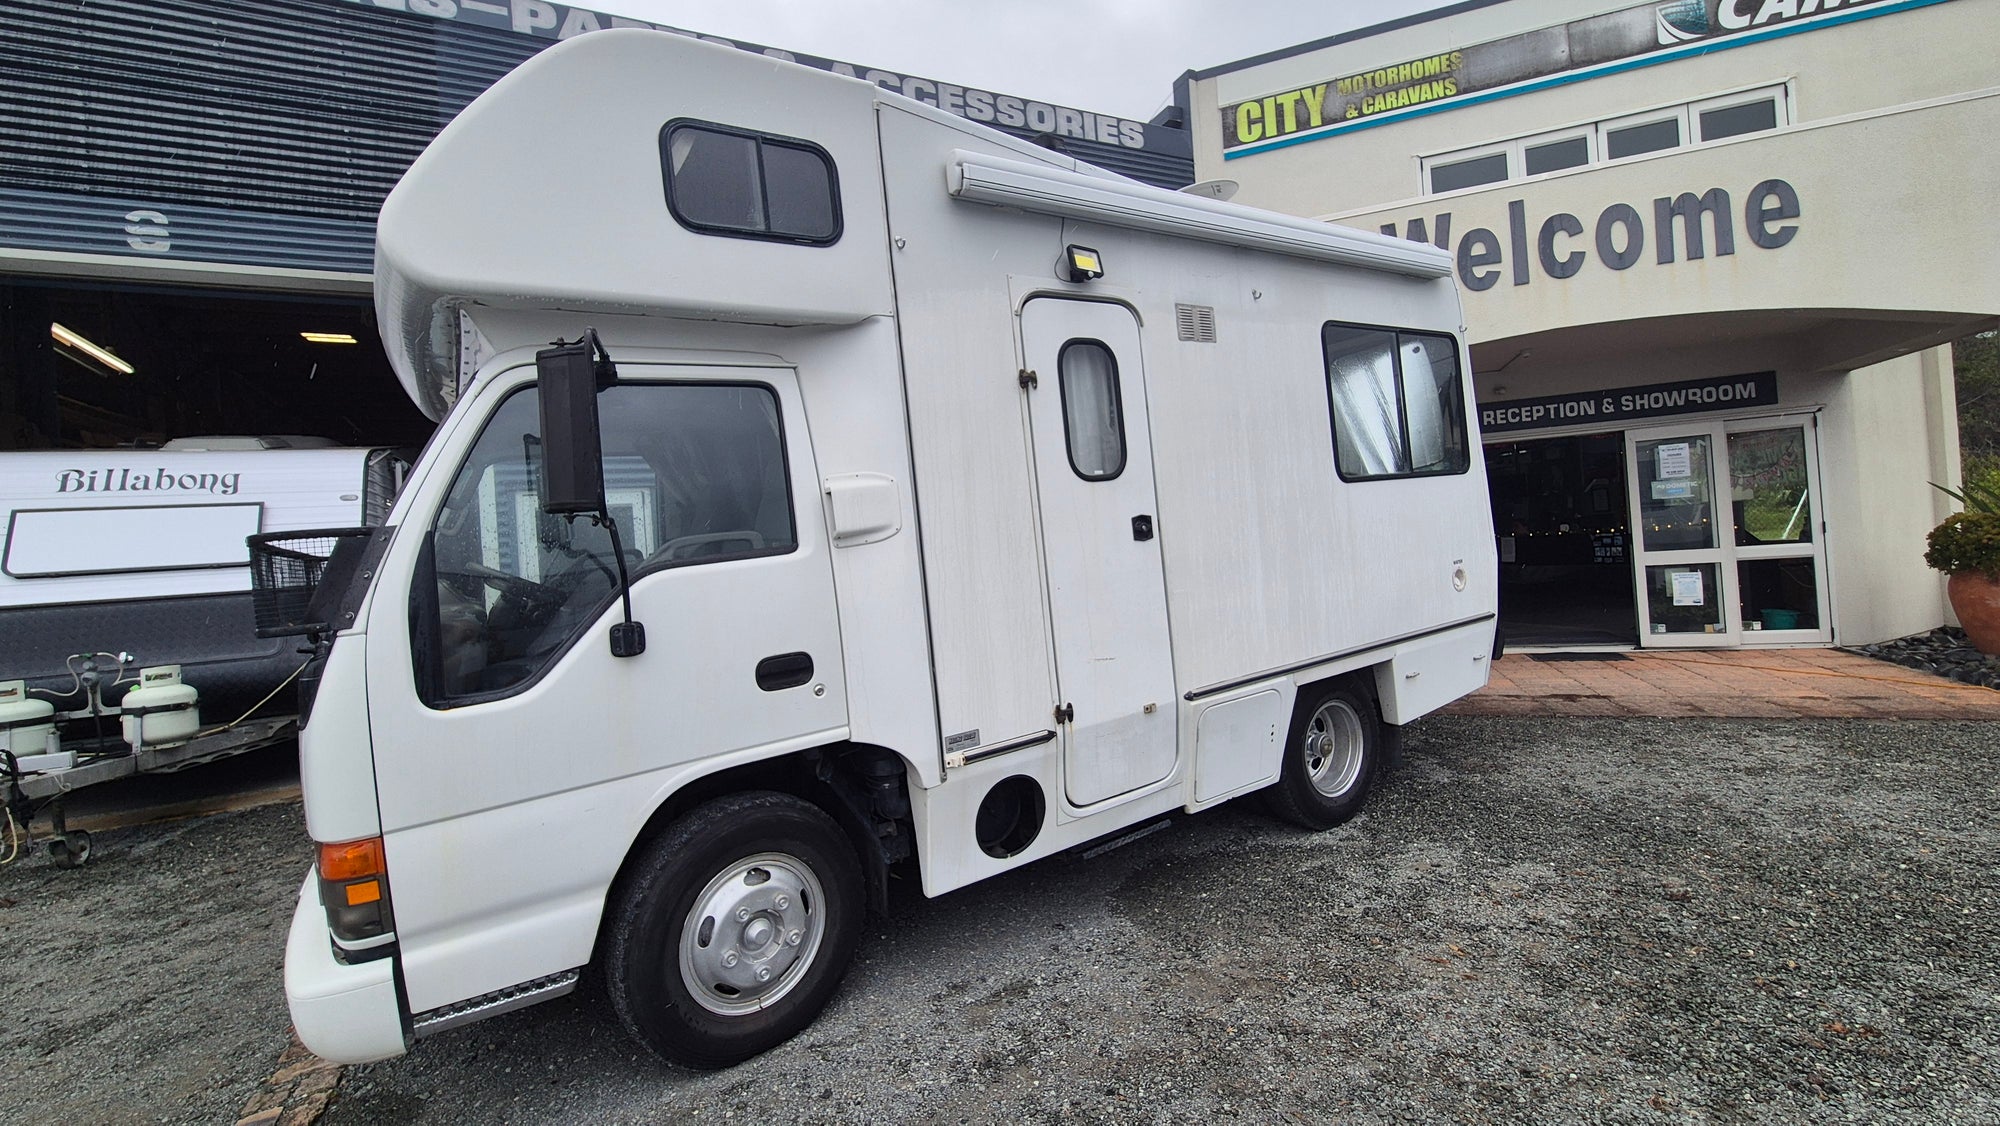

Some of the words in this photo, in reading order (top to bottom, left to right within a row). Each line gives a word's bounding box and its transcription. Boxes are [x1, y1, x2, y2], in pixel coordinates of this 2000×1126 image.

[1336, 51, 1463, 97] MOTORHOMES
[1236, 84, 1329, 144] CITY
[1346, 104, 1359, 118] &
[1362, 78, 1458, 115] CARAVANS
[1482, 400, 1595, 426] RECEPTION
[1602, 397, 1615, 413] &
[1621, 381, 1757, 411] SHOWROOM
[55, 467, 241, 495] Billabong
